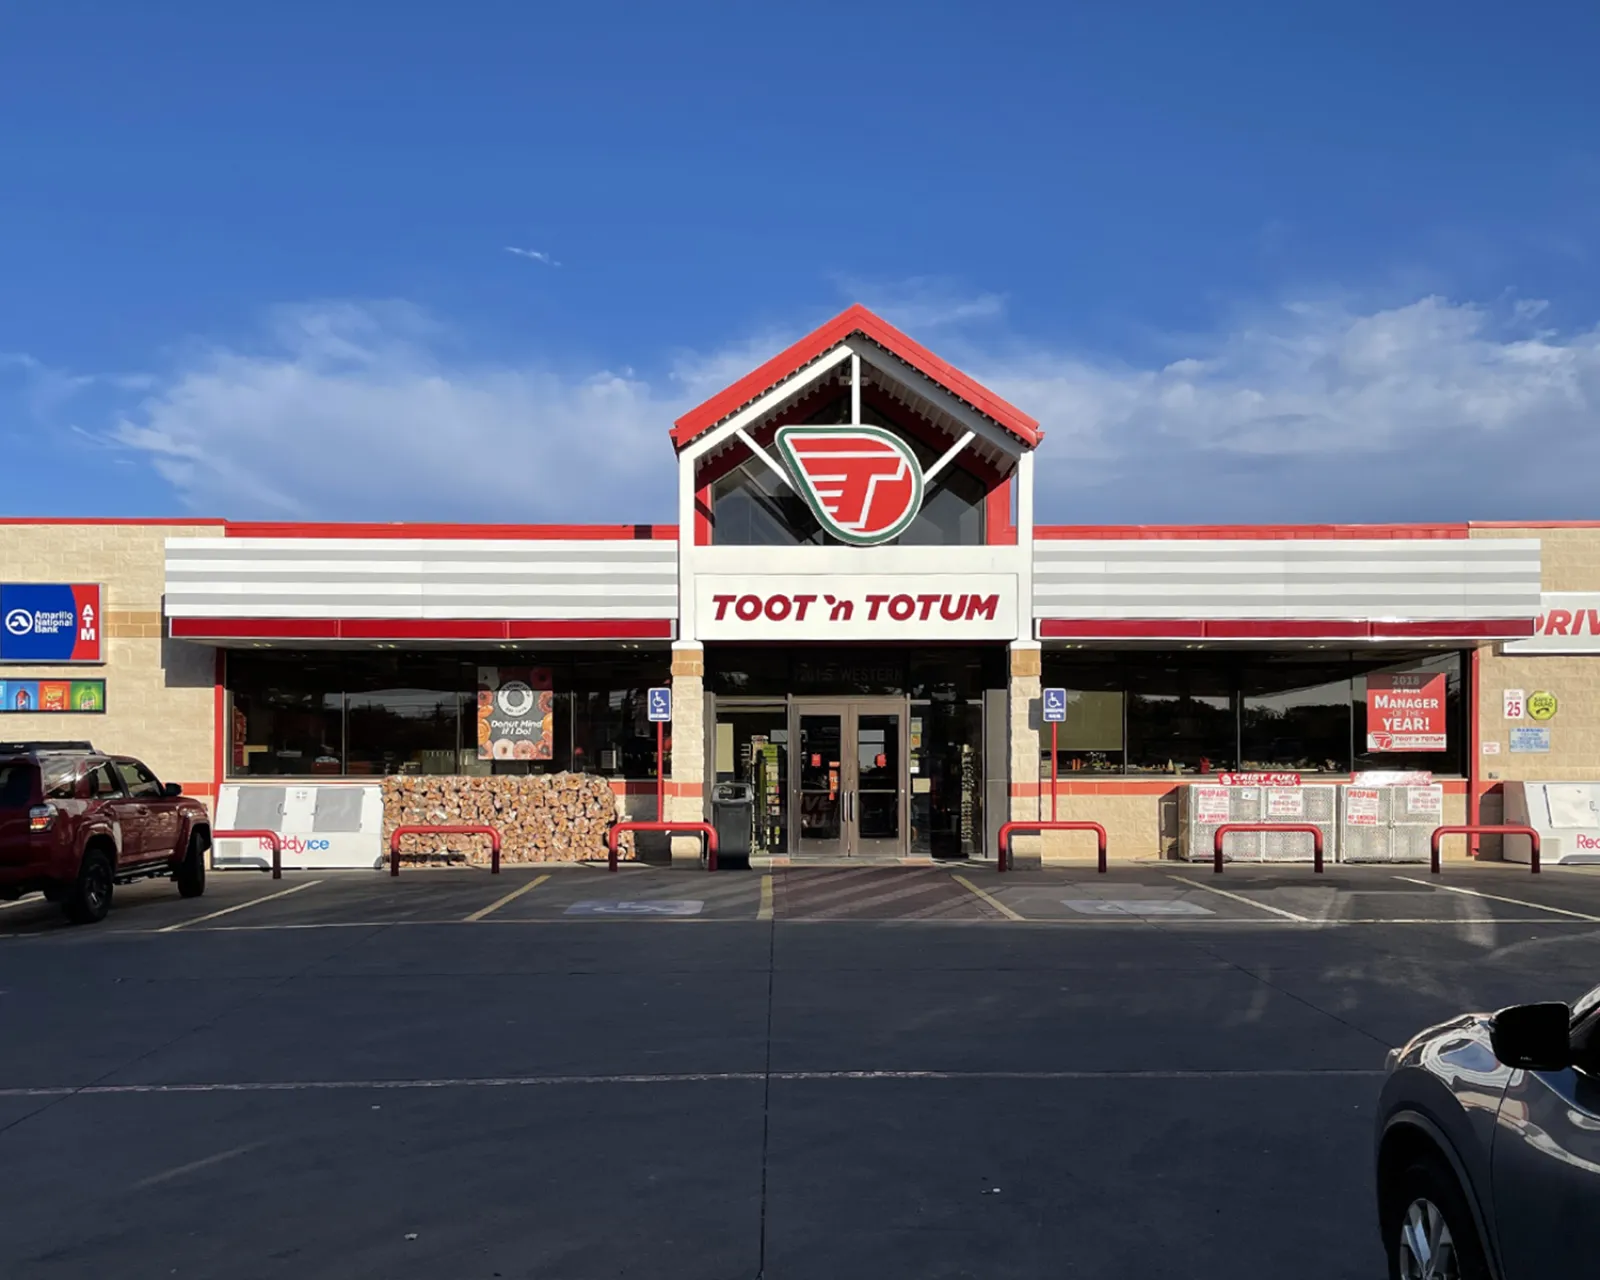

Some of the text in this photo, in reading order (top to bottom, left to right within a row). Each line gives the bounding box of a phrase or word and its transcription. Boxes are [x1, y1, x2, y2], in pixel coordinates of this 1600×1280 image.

[712, 594, 817, 621] TOOT
[865, 594, 1000, 621] TOTUM
[35, 611, 73, 619] Amarillo
[35, 619, 73, 627] National
[81, 604, 95, 640] ATM
[839, 667, 903, 682] WESTERN
[1392, 676, 1420, 685] 2018
[1374, 695, 1439, 709] MANAGER
[1507, 701, 1521, 717] 25
[491, 720, 542, 728] Donut Mind
[1383, 718, 1430, 730] YEAR!
[1232, 773, 1298, 782] CRIST FUEL
[1199, 789, 1228, 798] PROPANE
[1348, 789, 1378, 799] PROPANE
